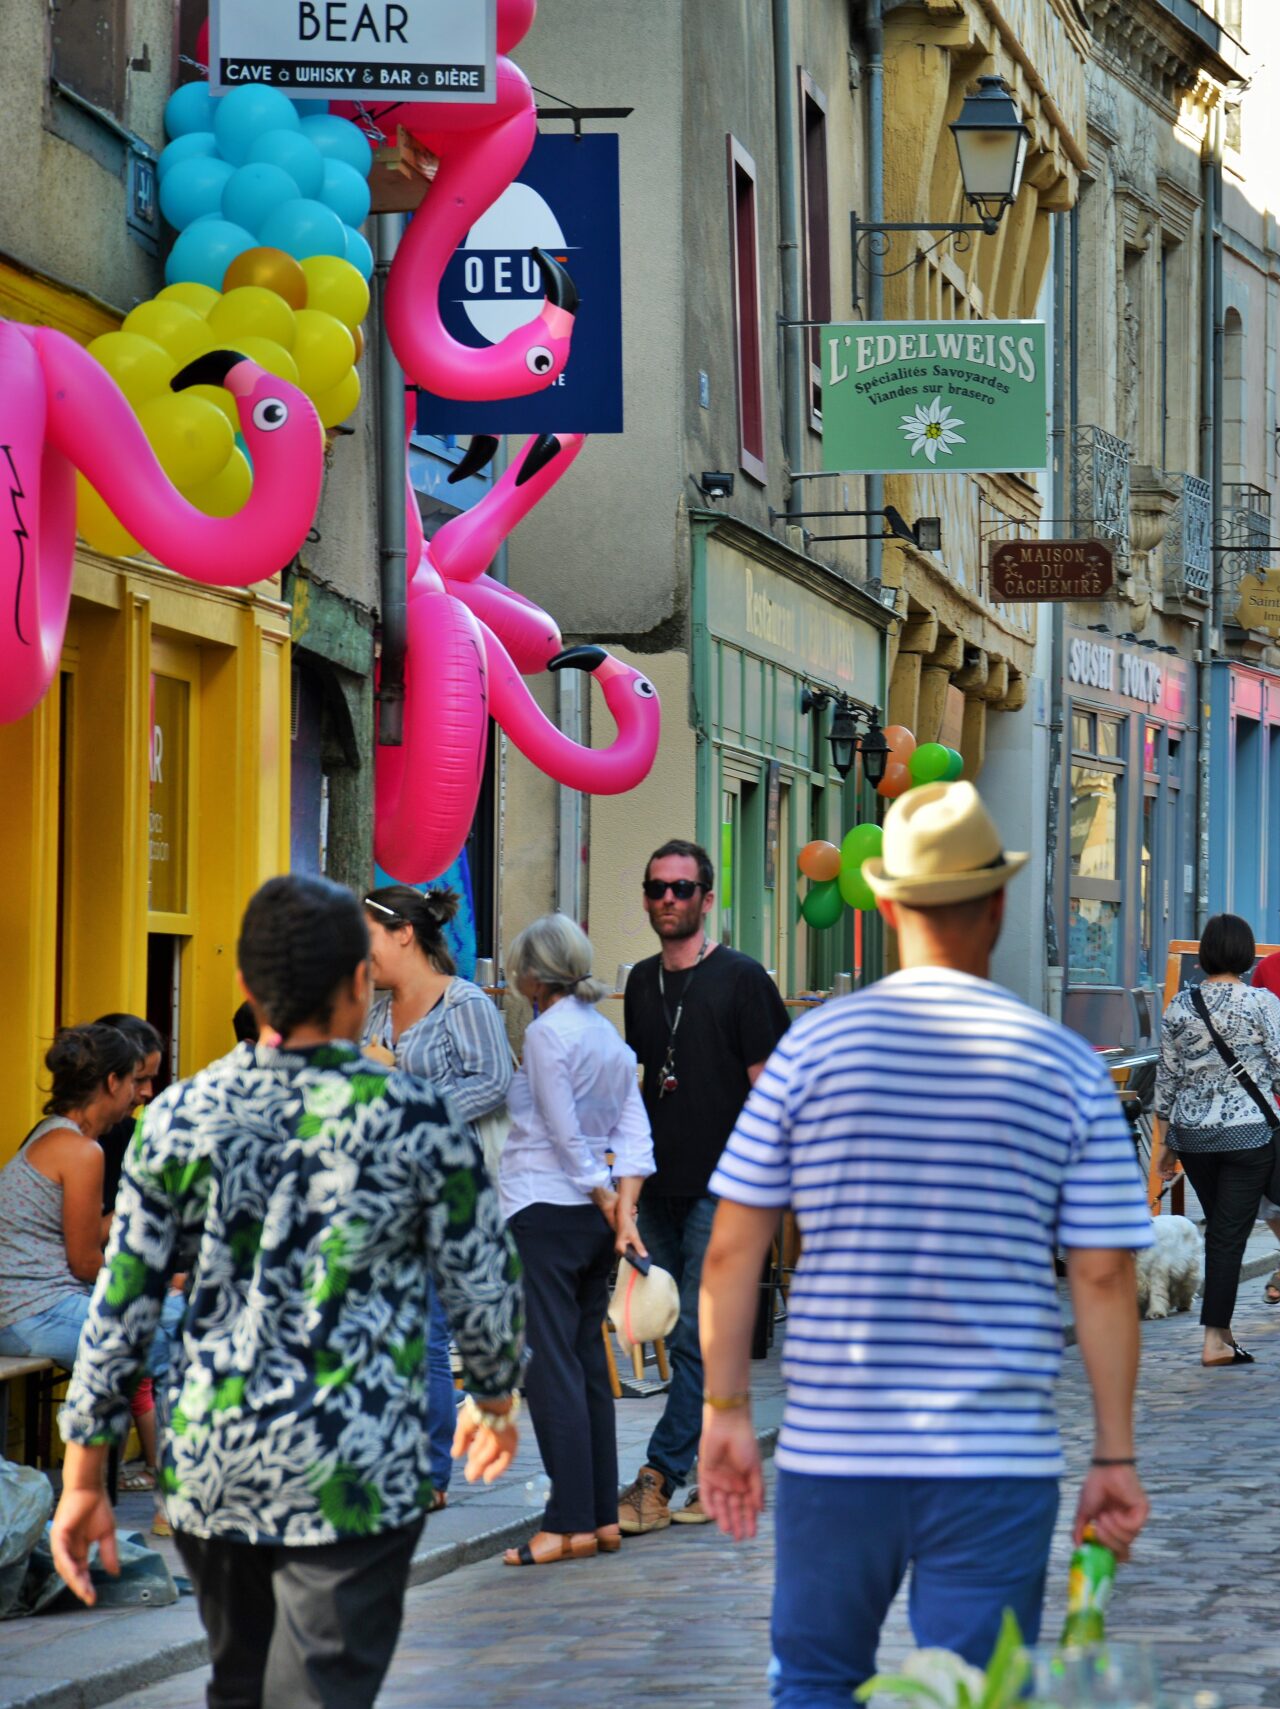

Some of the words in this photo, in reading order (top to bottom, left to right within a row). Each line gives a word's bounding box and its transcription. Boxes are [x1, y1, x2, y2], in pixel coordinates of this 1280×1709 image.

[299, 1, 409, 44] BEAR
[226, 64, 273, 81] CAVE
[278, 68, 290, 81] à
[296, 66, 356, 83] WHISKY
[362, 68, 374, 84] &
[380, 68, 411, 85] BAR
[417, 71, 429, 85] à
[435, 68, 479, 87] BIÈRE
[463, 255, 568, 294] OEU
[827, 332, 1037, 386] L'EDELWEISS
[854, 366, 928, 396] Spécialités
[932, 364, 1011, 395] Savoyardes
[867, 384, 919, 406] Viandes
[922, 383, 943, 395] sur
[947, 382, 996, 406] brasero
[1020, 548, 1085, 563] MAISON
[1040, 564, 1065, 579] DU
[1004, 579, 1104, 595] CACHEMIRE
[1248, 595, 1280, 608] Saint
[1068, 637, 1115, 692] SUSHI
